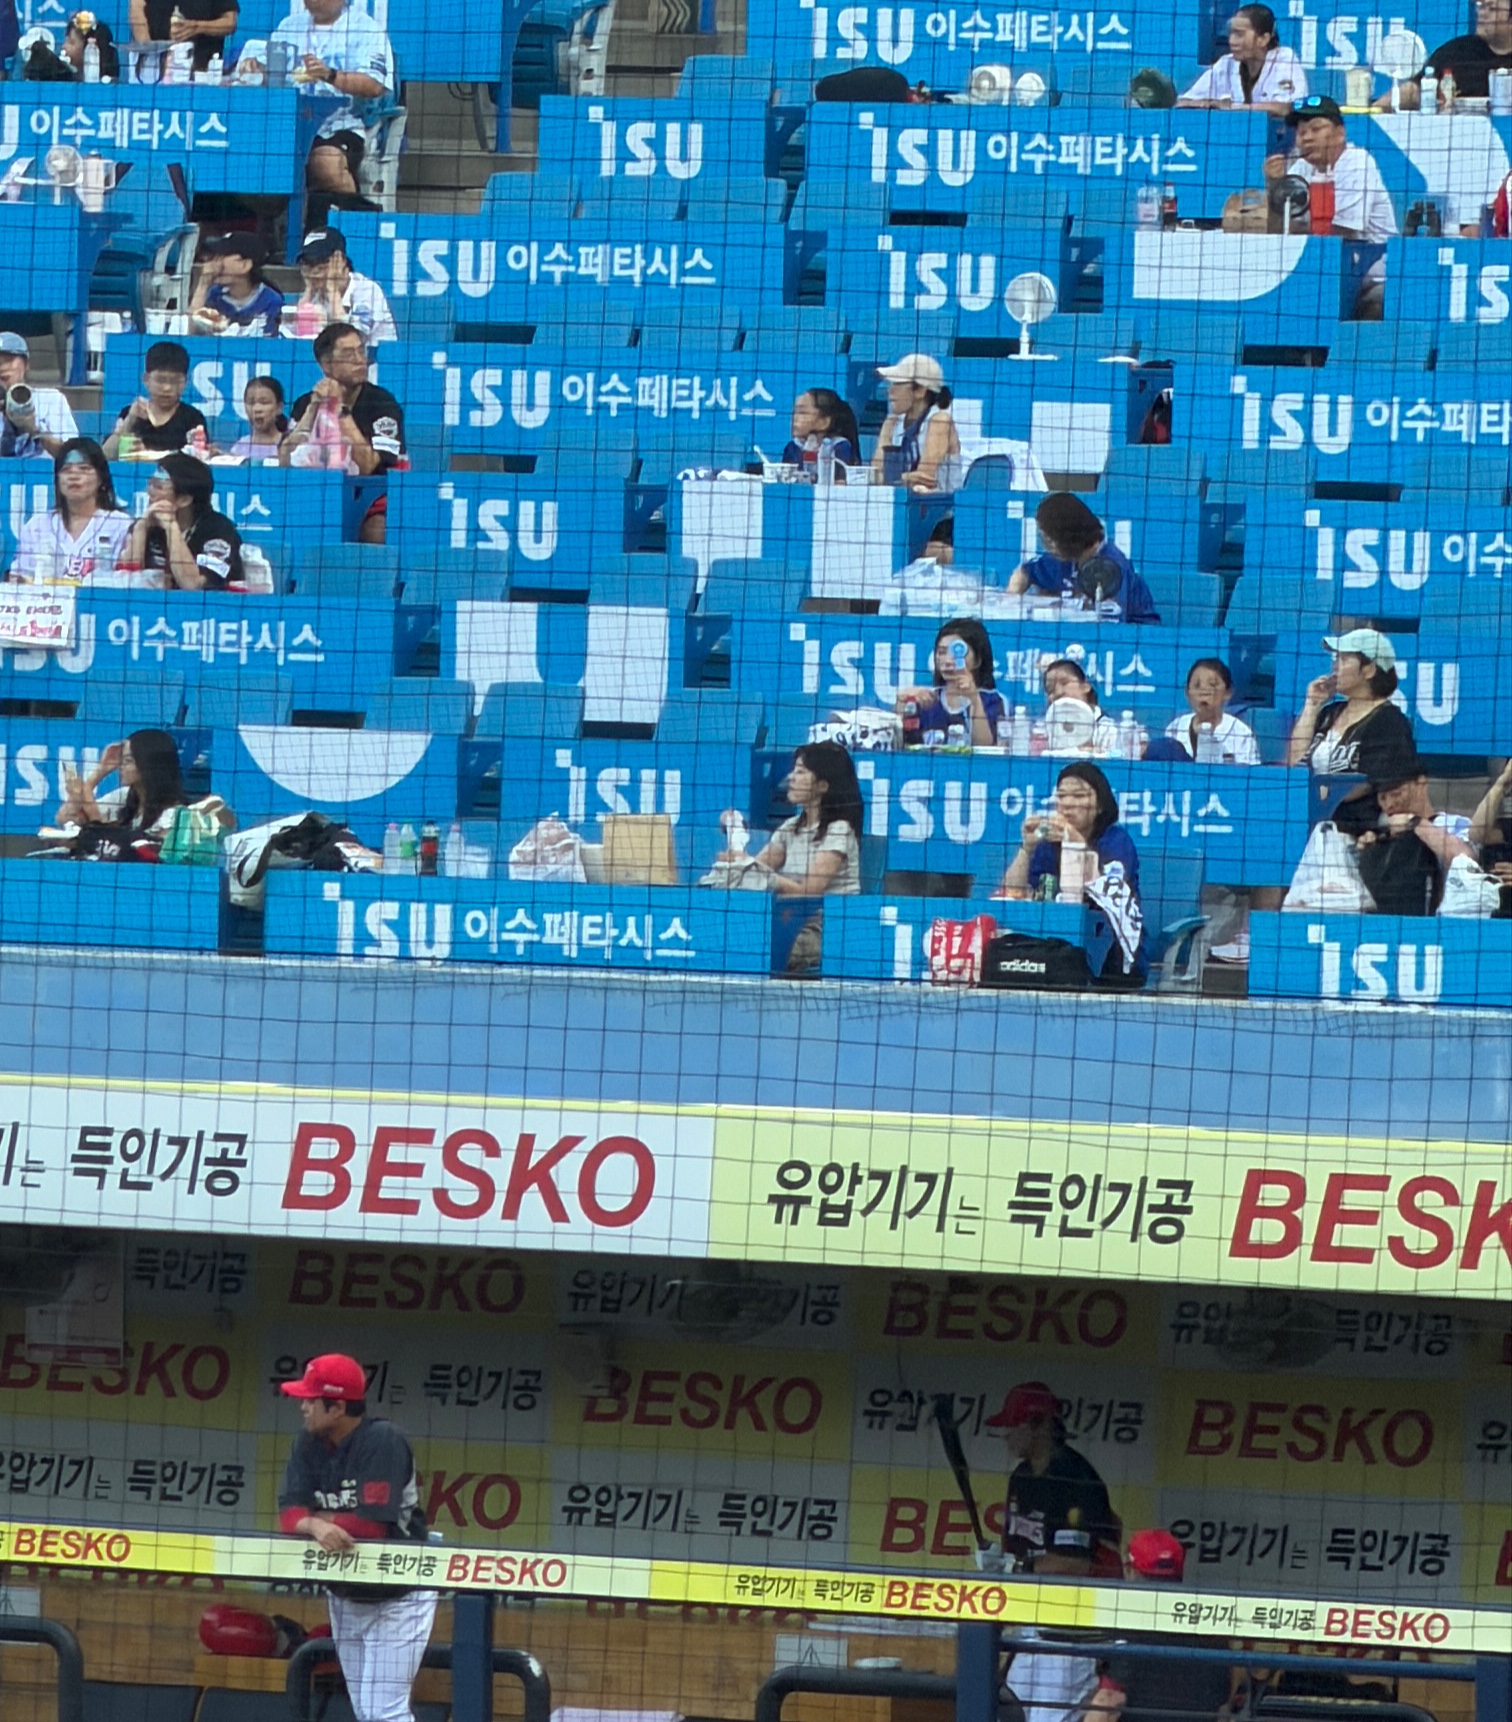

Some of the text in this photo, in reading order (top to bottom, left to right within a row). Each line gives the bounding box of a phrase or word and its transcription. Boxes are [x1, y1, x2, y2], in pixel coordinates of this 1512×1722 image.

[925, 11, 1132, 52] 이수페타시스
[30, 106, 229, 150] 이수페타시스
[987, 131, 1198, 177] 이수페타시스
[505, 244, 716, 287] 이수페타시스
[561, 374, 777, 421] 이수페타시스
[109, 616, 325, 665] 이수페타시스
[463, 906, 696, 961] 이수페타시스
[70, 1125, 248, 1198] 득인기공
[280, 1120, 657, 1229] BESKO
[768, 1158, 985, 1239] 유압기기는
[1006, 1171, 1195, 1246] 득인기공
[130, 1245, 250, 1295] 득인기공
[289, 1248, 527, 1314] BESKO
[883, 1281, 1129, 1348] BESKO
[423, 1362, 543, 1412] 득인기공
[581, 1371, 823, 1434] BESKO
[1185, 1400, 1436, 1469] BESKO
[126, 1459, 246, 1507] 득인기공
[560, 1483, 701, 1533] 유압기기는
[716, 1492, 838, 1542] 득인기공
[13, 1528, 131, 1562] BESKO
[1325, 1526, 1452, 1578] 득인기공
[445, 1553, 568, 1589] BESKO
[884, 1580, 1008, 1616] BESKO
[1323, 1608, 1451, 1646] BESKO
